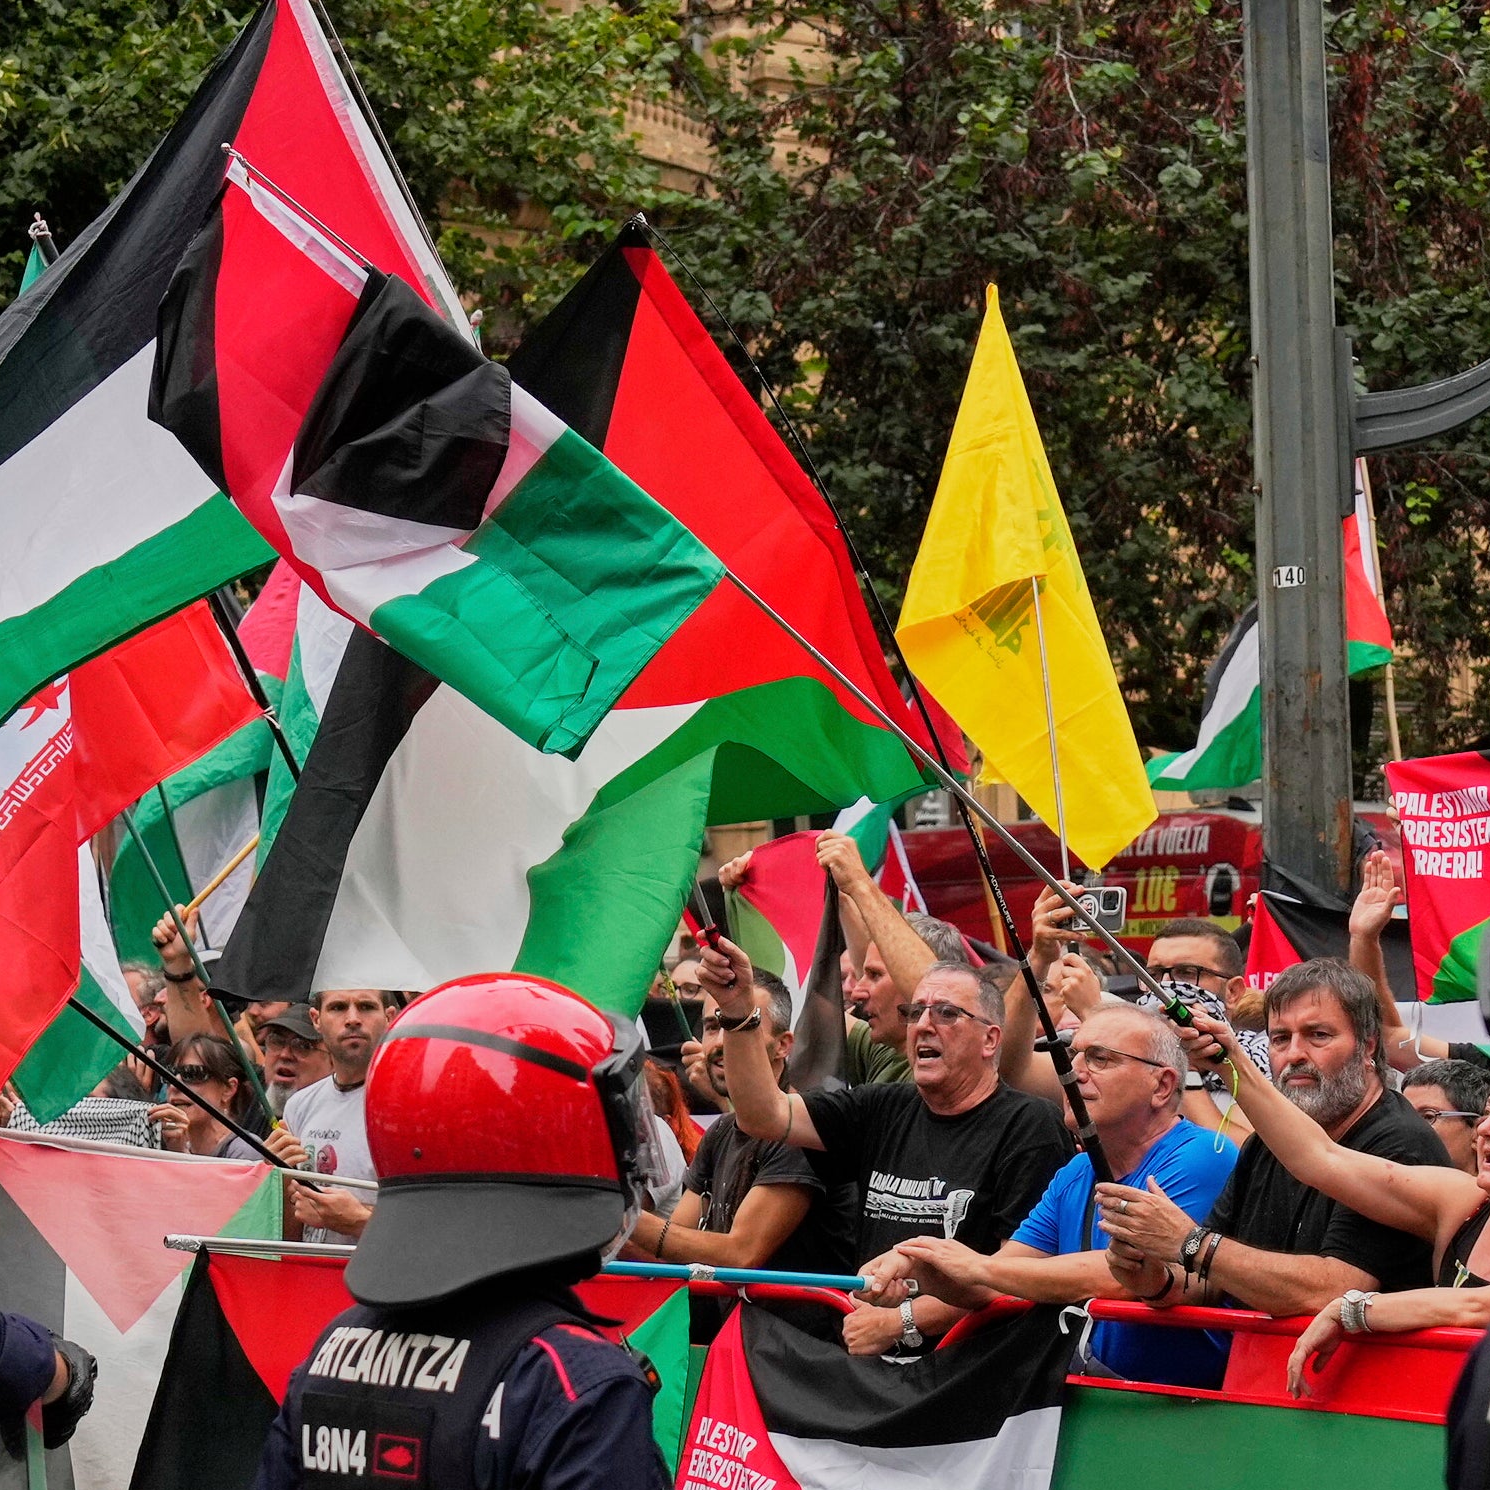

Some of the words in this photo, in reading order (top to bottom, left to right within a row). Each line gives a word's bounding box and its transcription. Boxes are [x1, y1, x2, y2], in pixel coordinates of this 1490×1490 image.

[1274, 566, 1306, 587] 140
[1136, 829, 1154, 857] LA
[1157, 825, 1210, 856] VUELTA
[1412, 849, 1483, 879] RRERA!
[989, 873, 1013, 924] ADVENTURE
[1131, 865, 1180, 913] 10€
[308, 1326, 472, 1393] ERTZAINTZA
[302, 1423, 367, 1477] L8N4
